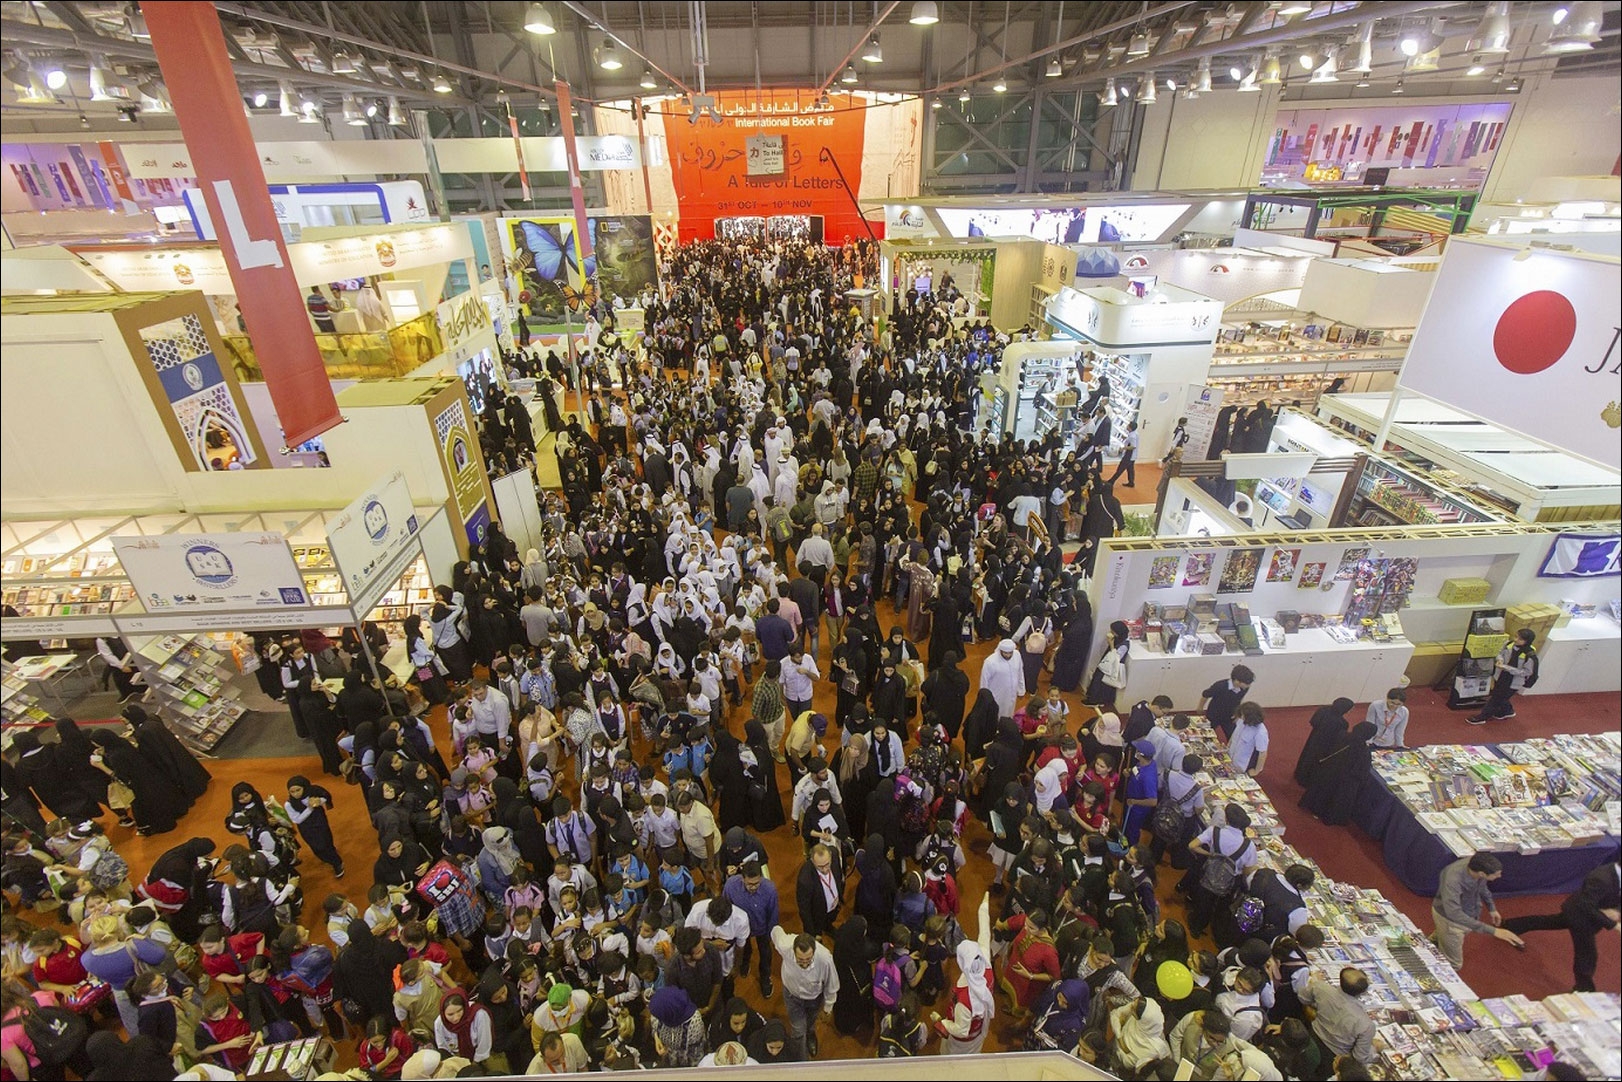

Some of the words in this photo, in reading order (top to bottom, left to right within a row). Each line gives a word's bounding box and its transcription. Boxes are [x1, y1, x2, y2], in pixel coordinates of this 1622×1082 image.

[735, 116, 790, 128] International
[792, 115, 816, 127] Book
[817, 115, 835, 126] Fair
[727, 174, 739, 188] A
[793, 175, 844, 189] Letters
[737, 201, 757, 209] OCT
[792, 199, 813, 208] NOV
[428, 885, 442, 897] I
[436, 878, 460, 902] SHJ
